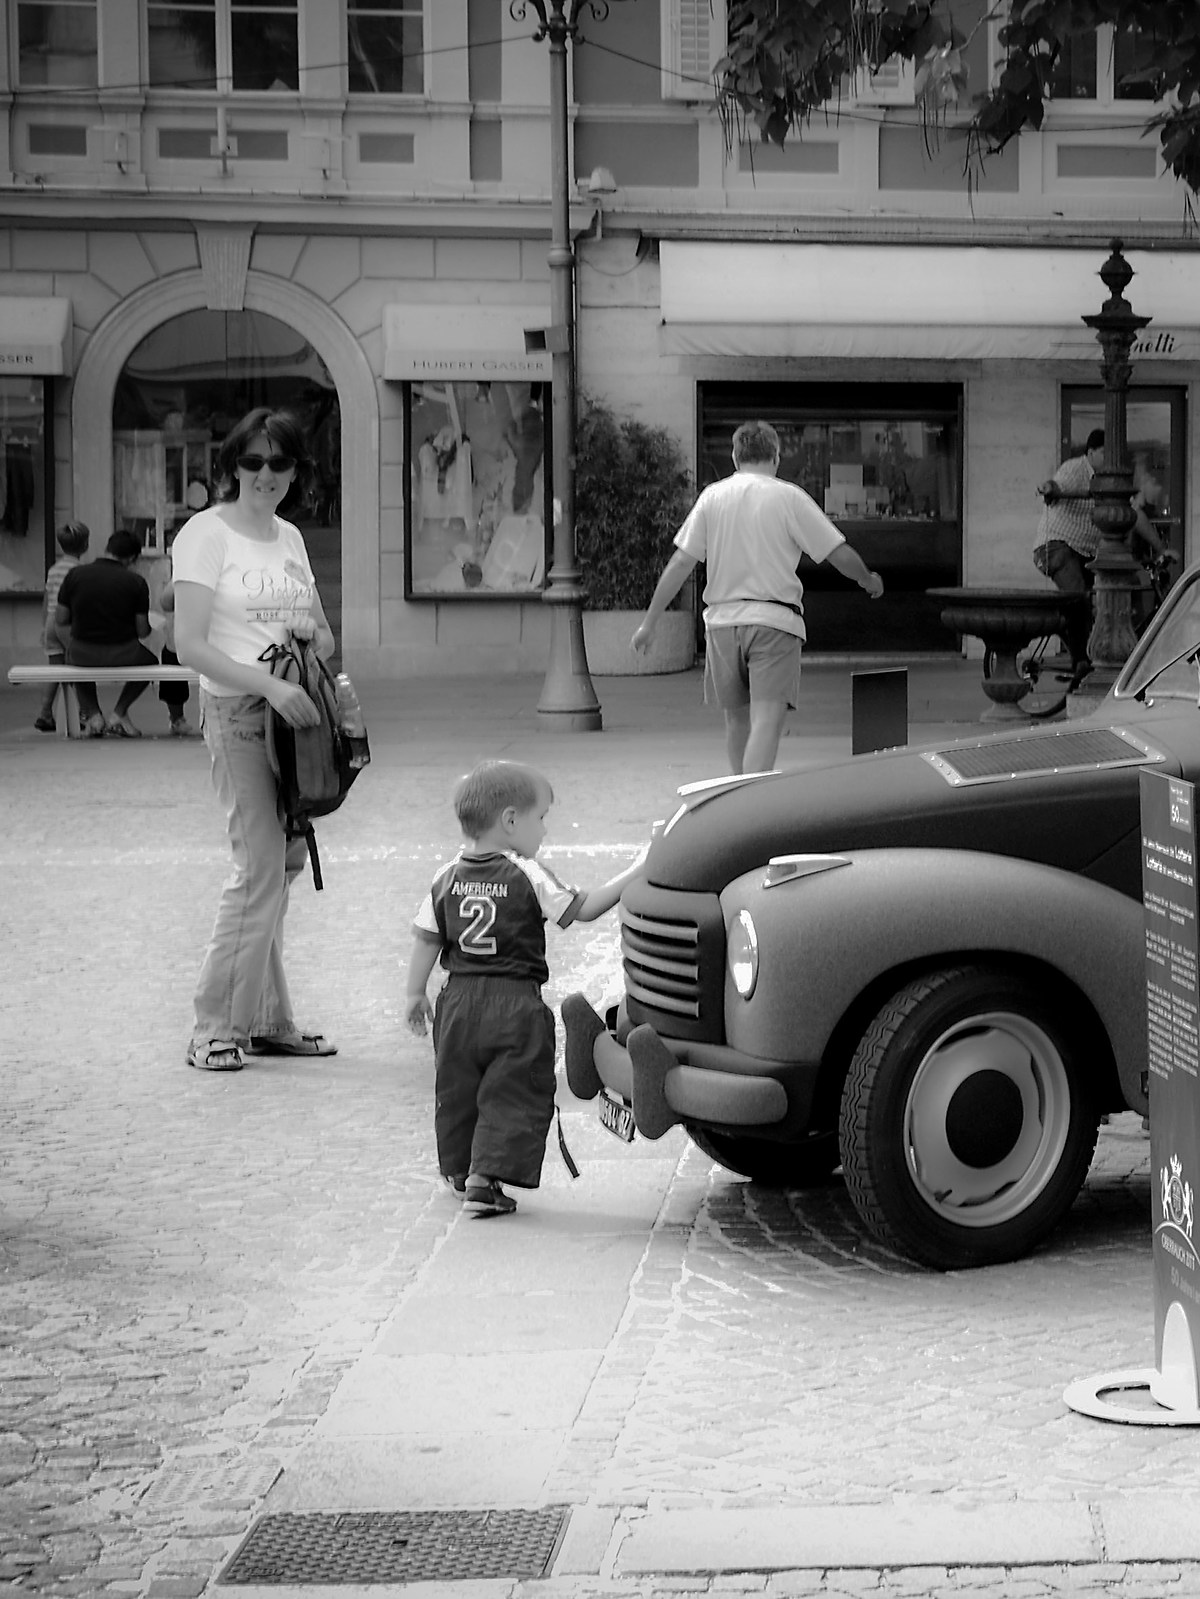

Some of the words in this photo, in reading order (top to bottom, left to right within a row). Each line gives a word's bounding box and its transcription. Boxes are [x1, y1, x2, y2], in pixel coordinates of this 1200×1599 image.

[412, 360, 475, 370] HUBERT
[482, 361, 544, 371] GASSER
[451, 881, 508, 898] AMERICAN
[458, 896, 497, 955] 2
